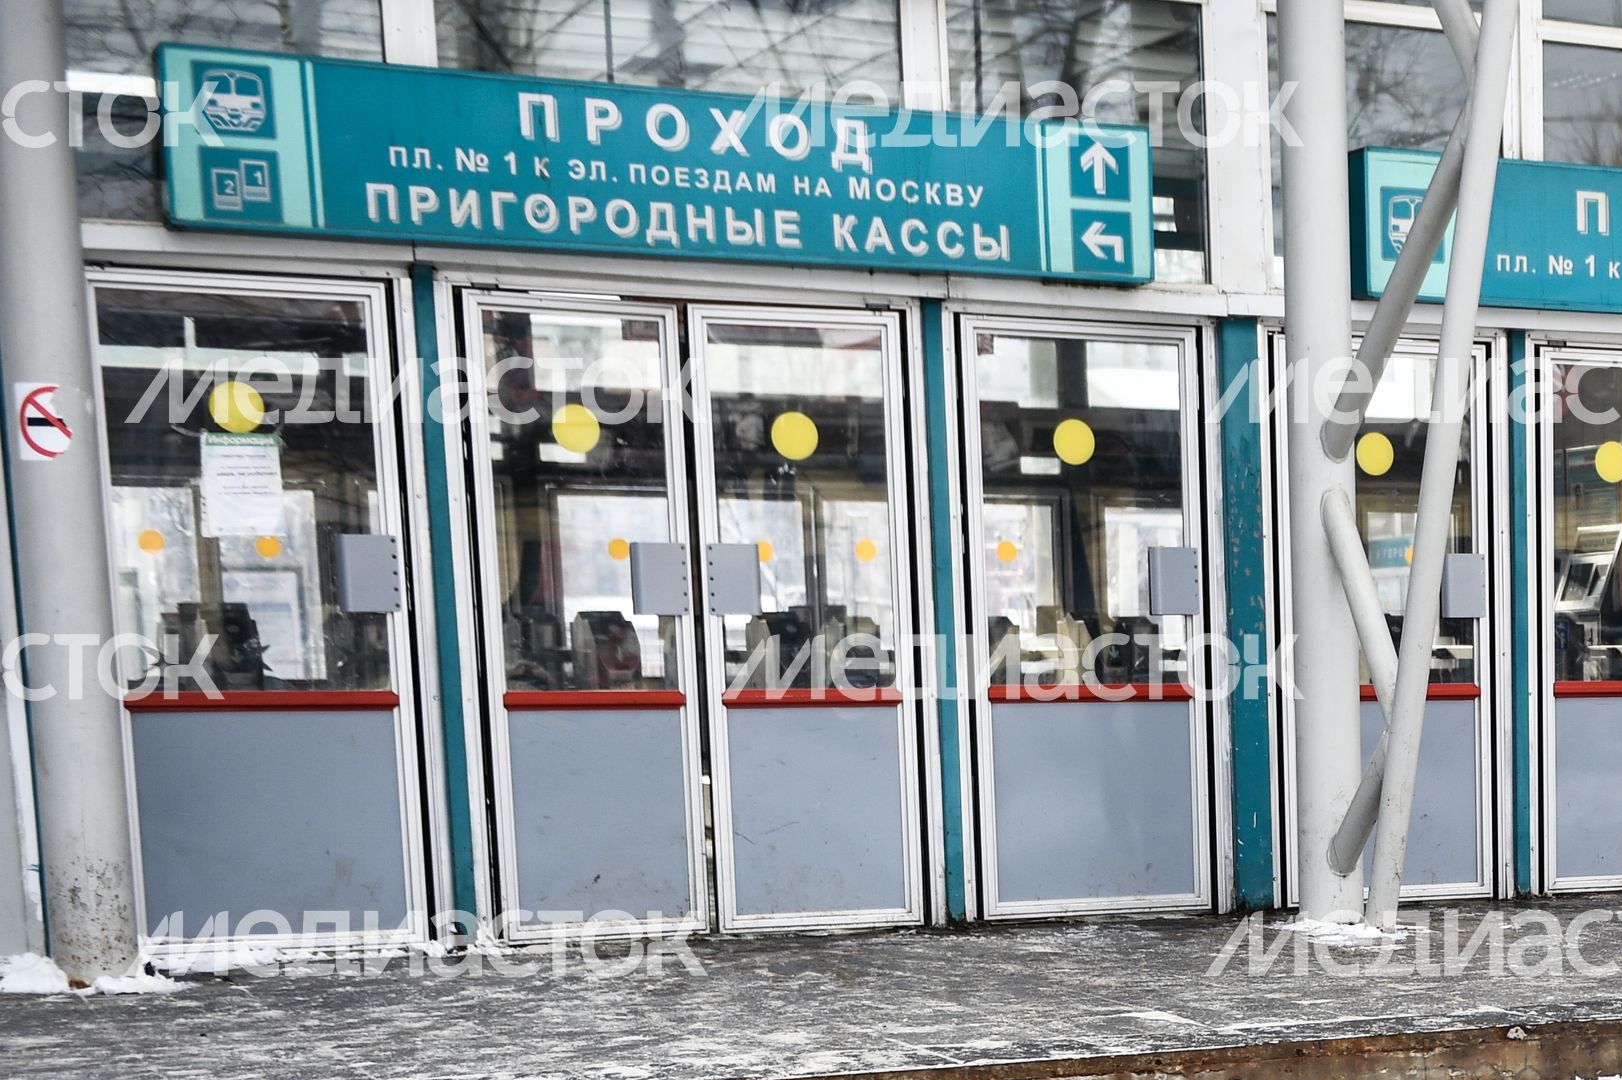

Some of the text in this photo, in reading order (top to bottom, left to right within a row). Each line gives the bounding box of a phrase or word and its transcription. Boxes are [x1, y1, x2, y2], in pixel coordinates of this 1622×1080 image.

[518, 91, 874, 174] ПРОХОД
[389, 146, 984, 208] ПЛ. № 1 К ЭЛ. ПОЕЗДАМ НА МОСКВУ
[365, 182, 1011, 262] ПРИГОРОДНЫЕ КАССЫ
[1496, 254, 1537, 274] ПЛ.
[1548, 254, 1574, 276] №
[1585, 254, 1596, 278] 1
[1608, 261, 1621, 280] К
